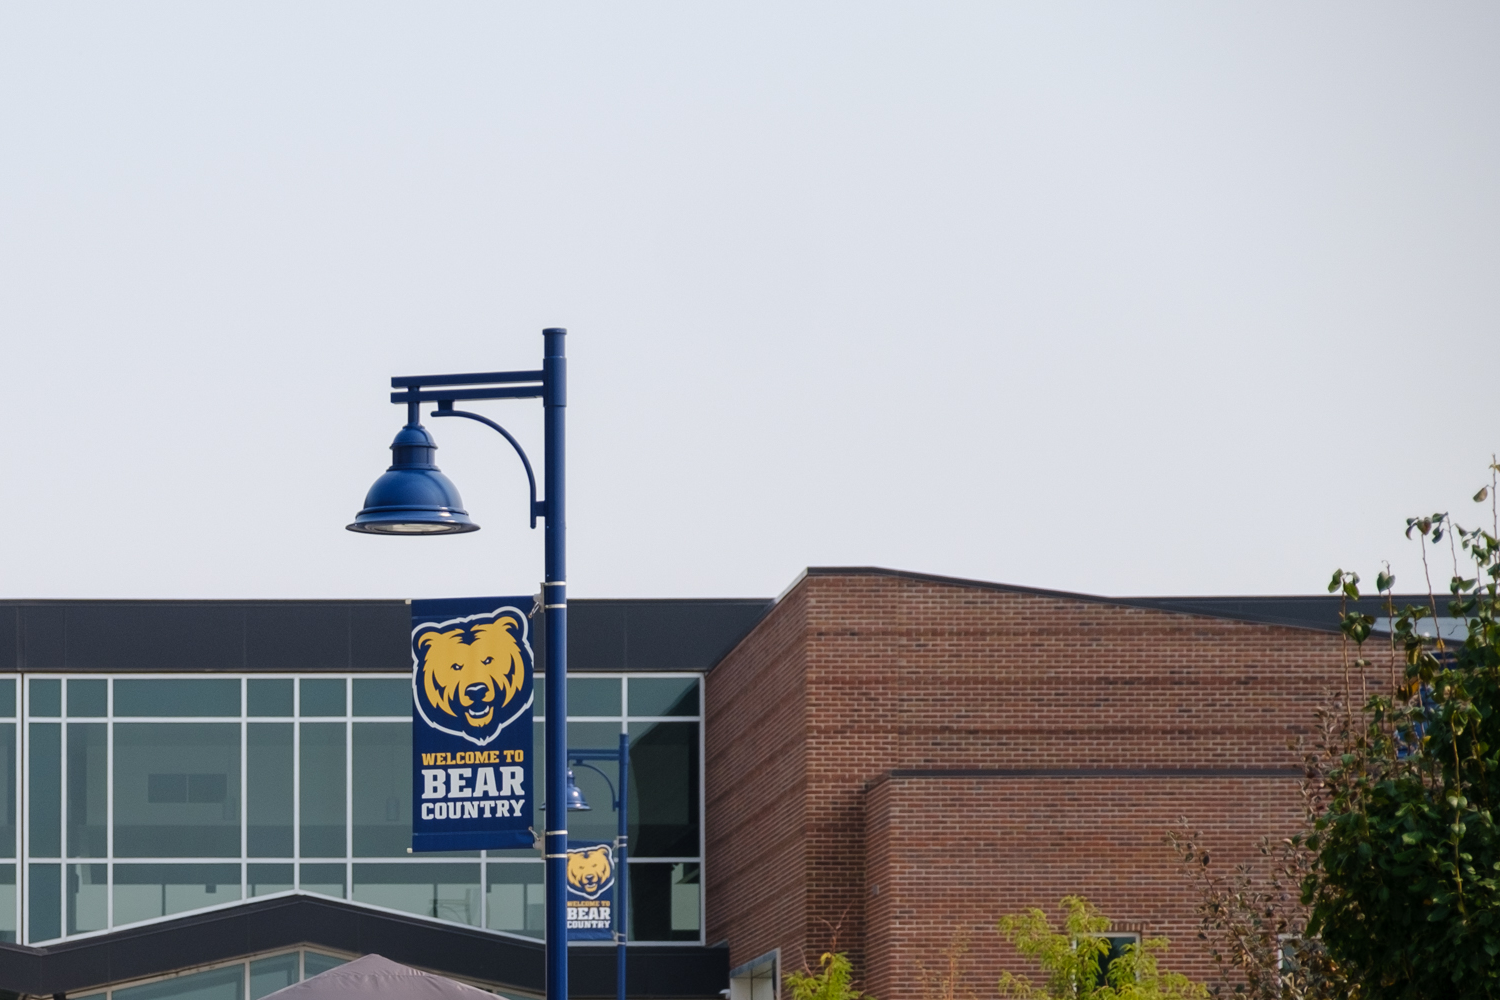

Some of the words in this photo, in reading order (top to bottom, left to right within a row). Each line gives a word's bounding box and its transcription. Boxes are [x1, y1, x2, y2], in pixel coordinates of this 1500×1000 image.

[421, 750, 500, 766] WELCOME
[503, 749, 524, 763] TO
[421, 766, 525, 799] BEAR
[421, 799, 526, 820] COUNTRY
[566, 907, 611, 920] BEAR
[566, 920, 611, 928] COUNTRY
